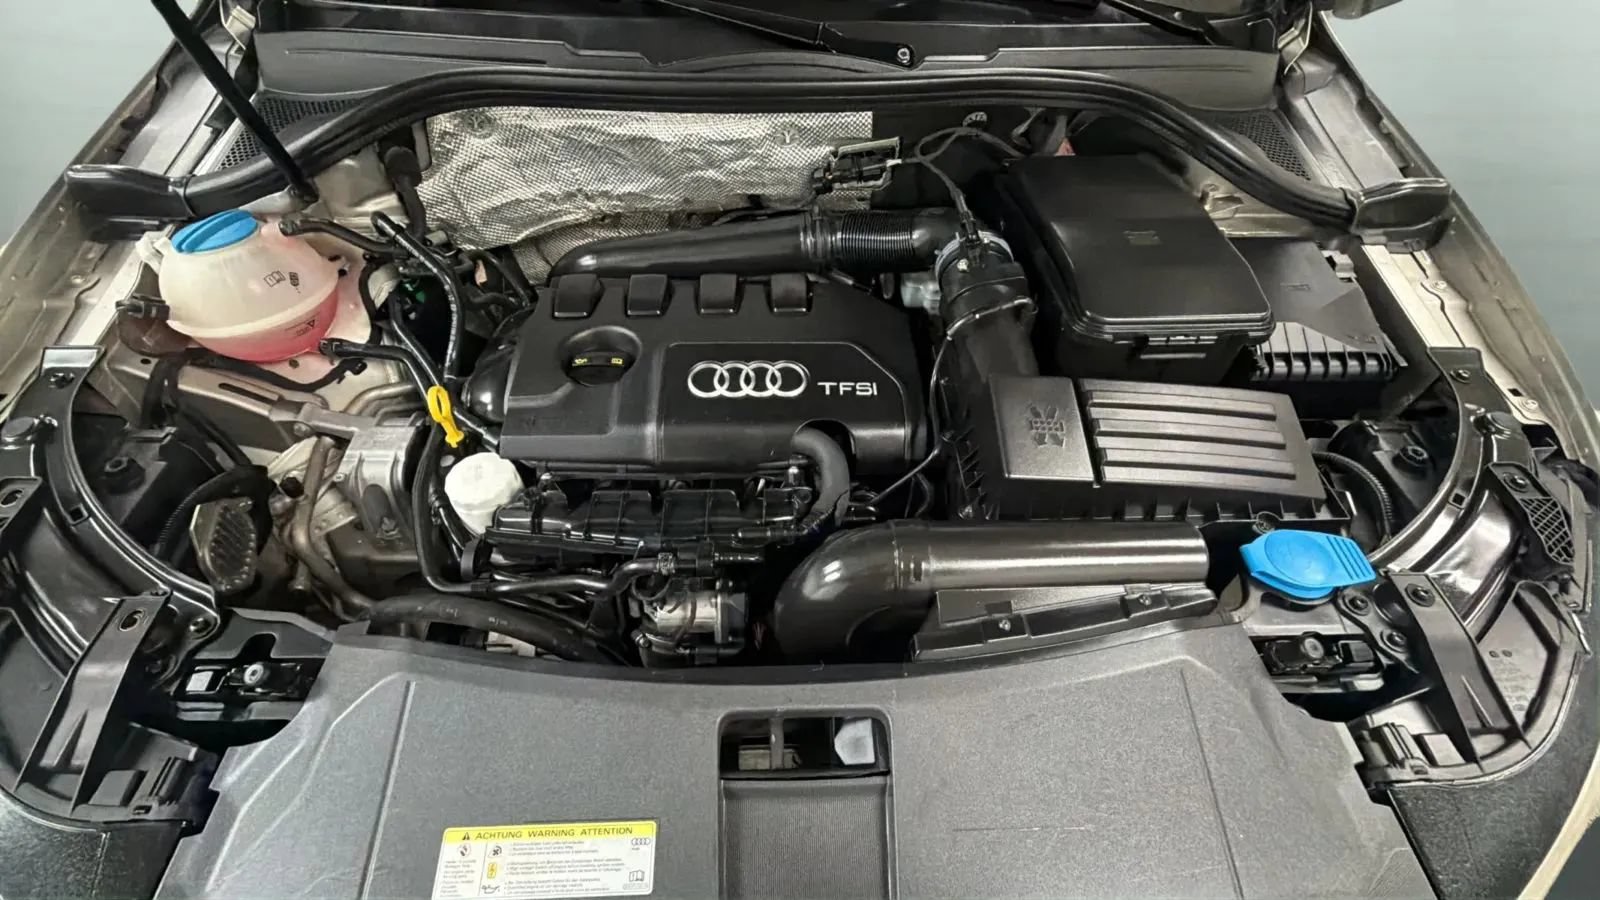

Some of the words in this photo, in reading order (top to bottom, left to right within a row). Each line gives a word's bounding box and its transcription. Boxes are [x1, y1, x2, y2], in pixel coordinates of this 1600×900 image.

[817, 382, 878, 396] TFSI
[475, 830, 523, 840] ACHTUNG
[528, 828, 575, 838] WARNING
[580, 826, 633, 836] ATTENTION
